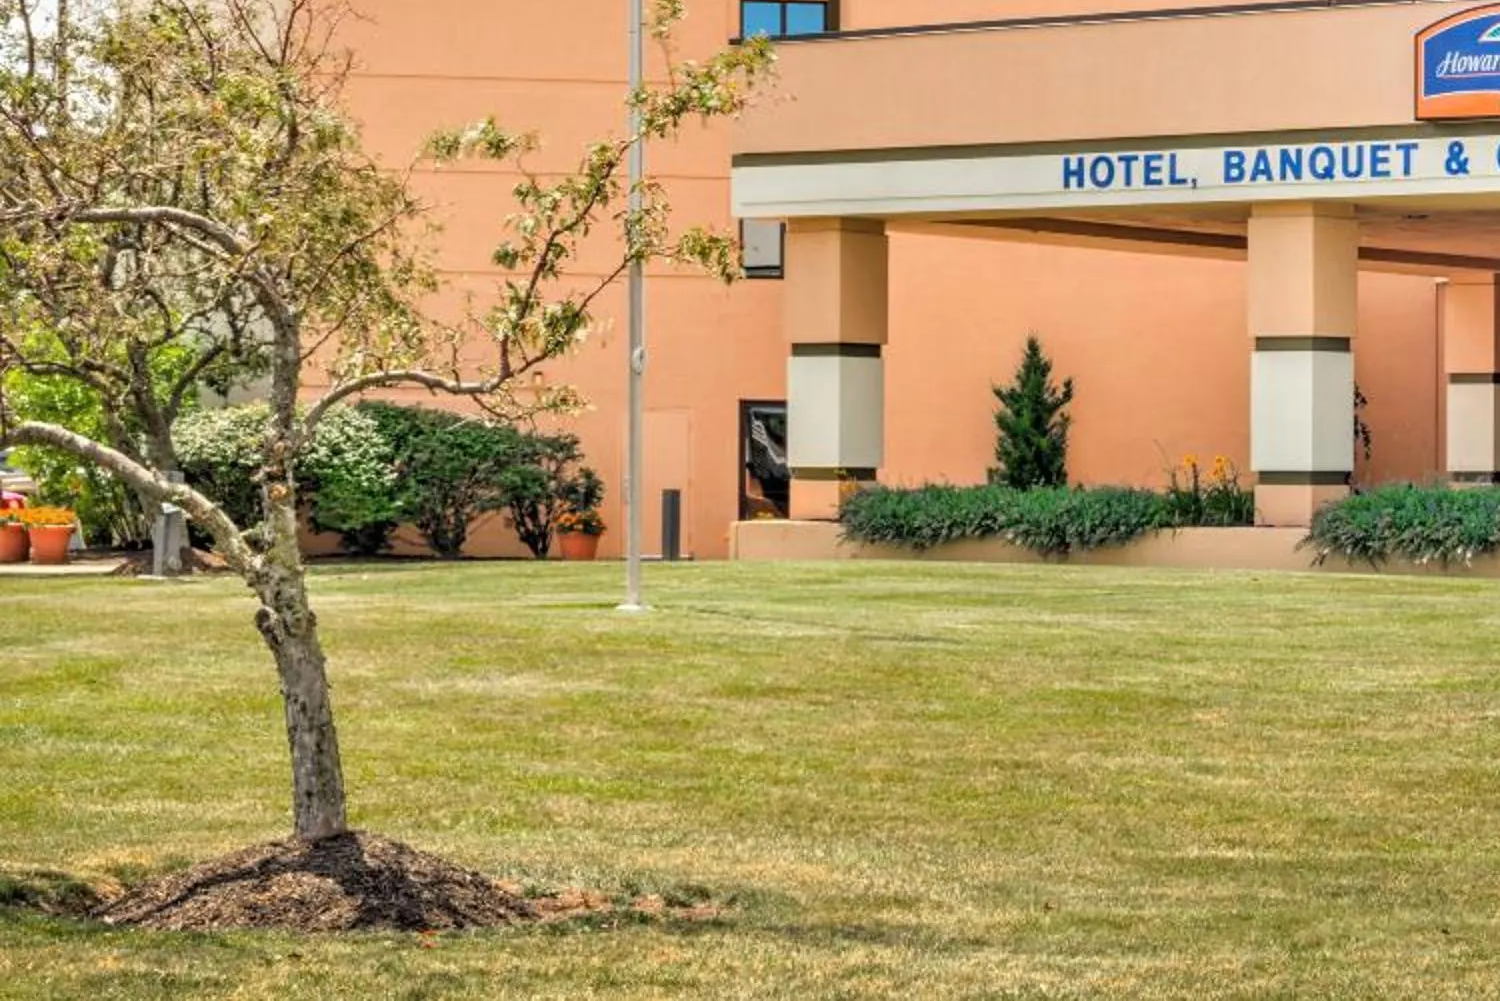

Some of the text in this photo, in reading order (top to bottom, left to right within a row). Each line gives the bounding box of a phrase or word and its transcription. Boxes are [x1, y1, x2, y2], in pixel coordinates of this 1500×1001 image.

[1063, 152, 1198, 190] HOTEL,
[1223, 142, 1419, 184] BANQUET
[1444, 140, 1470, 176] &
